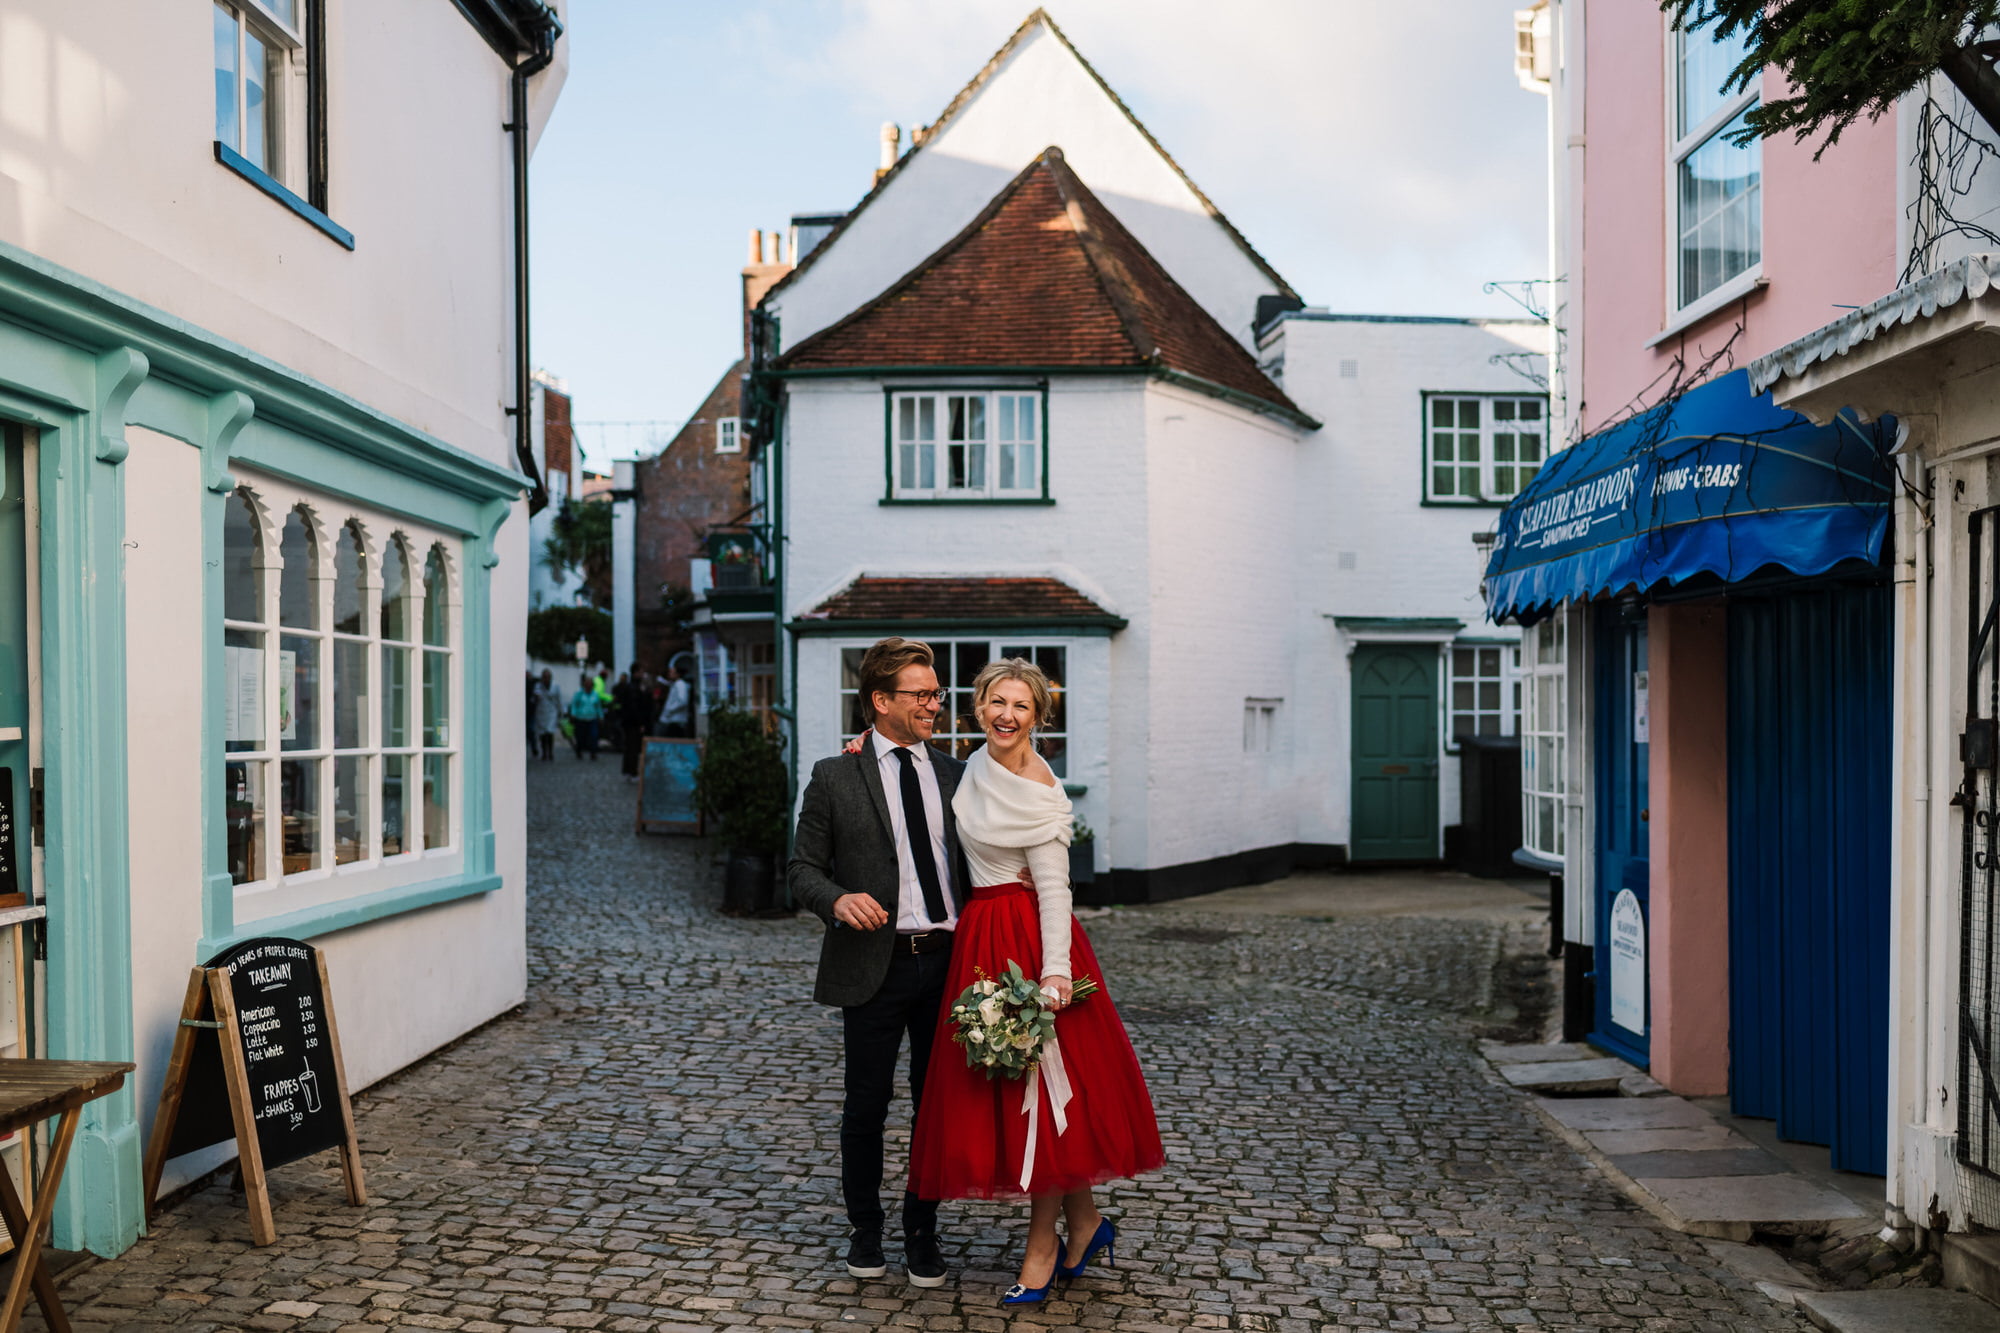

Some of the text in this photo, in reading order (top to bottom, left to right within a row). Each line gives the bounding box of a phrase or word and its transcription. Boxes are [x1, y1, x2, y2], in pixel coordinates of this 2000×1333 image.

[1514, 463, 1640, 547] SEAFAYRE SEAFOODS
[1540, 515, 1592, 549] SANDWICHES
[227, 945, 308, 976] 10 YEARS OF PROPER COFFEE
[248, 962, 292, 986] TAKEAWAY
[241, 1006, 276, 1023] Americano
[243, 1018, 281, 1036] Cappuccino
[246, 1035, 268, 1049] Latte
[248, 1049, 264, 1063] Flat
[263, 1044, 284, 1059] White
[263, 1078, 299, 1101] FRAPPES
[265, 1098, 295, 1118] SHAKES
